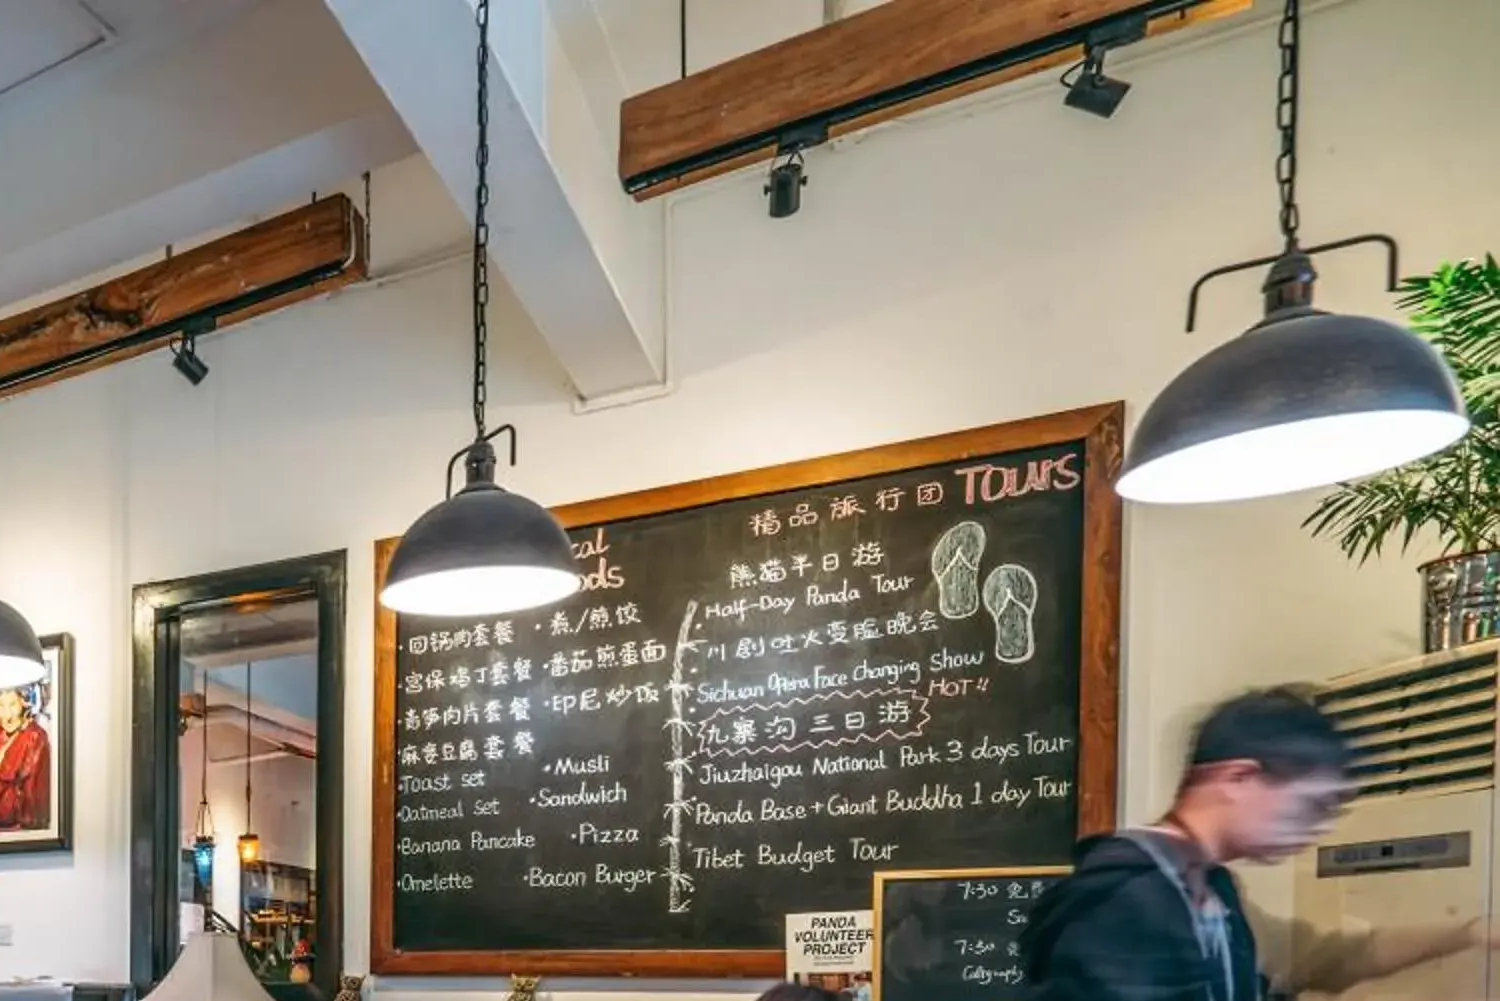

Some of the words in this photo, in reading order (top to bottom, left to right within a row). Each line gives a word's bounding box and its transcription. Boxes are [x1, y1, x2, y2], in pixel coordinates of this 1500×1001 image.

[749, 483, 944, 537] 精品旅行团
[728, 541, 885, 589] 熊猫半日游
[705, 593, 795, 622] Half-Day
[805, 579, 861, 607] Panda
[871, 573, 915, 595] Tour
[409, 620, 515, 655] 回锅肉套餐
[696, 679, 765, 704] Sichuan
[767, 672, 811, 694] Opera
[812, 664, 848, 689] Face
[853, 660, 922, 683] Changing
[552, 682, 660, 715] 印尼炒饭
[706, 699, 912, 745] 九寨沟三日游
[554, 755, 610, 775] Musli
[699, 761, 803, 789] Jiuzhaigou
[812, 749, 888, 776] National
[900, 745, 942, 768] Park
[947, 739, 963, 762] 3
[971, 735, 1020, 765] days
[1024, 730, 1073, 755] Tour
[401, 775, 451, 793] Toast
[461, 771, 485, 788] set
[537, 782, 627, 808] Sandwich
[401, 802, 464, 822] Oatmeal
[694, 801, 753, 825] Panda
[761, 798, 807, 821] Base
[827, 793, 878, 816] Giant
[884, 783, 964, 812] Buddha
[970, 781, 983, 806] 1
[991, 779, 1032, 808] day
[1033, 775, 1073, 800] Tour
[401, 837, 461, 856] Banana
[470, 828, 536, 850] Pancake
[579, 822, 640, 845] Pizza
[692, 847, 746, 869] Tibet
[757, 841, 836, 873] Budget
[849, 837, 899, 861] Tour
[401, 873, 473, 892] Omelette
[529, 866, 587, 888] Bacon
[595, 864, 657, 893] Burger
[794, 929, 874, 943] VOLUNTEER
[811, 916, 856, 929] PANDA
[803, 941, 866, 955] PROJECT
